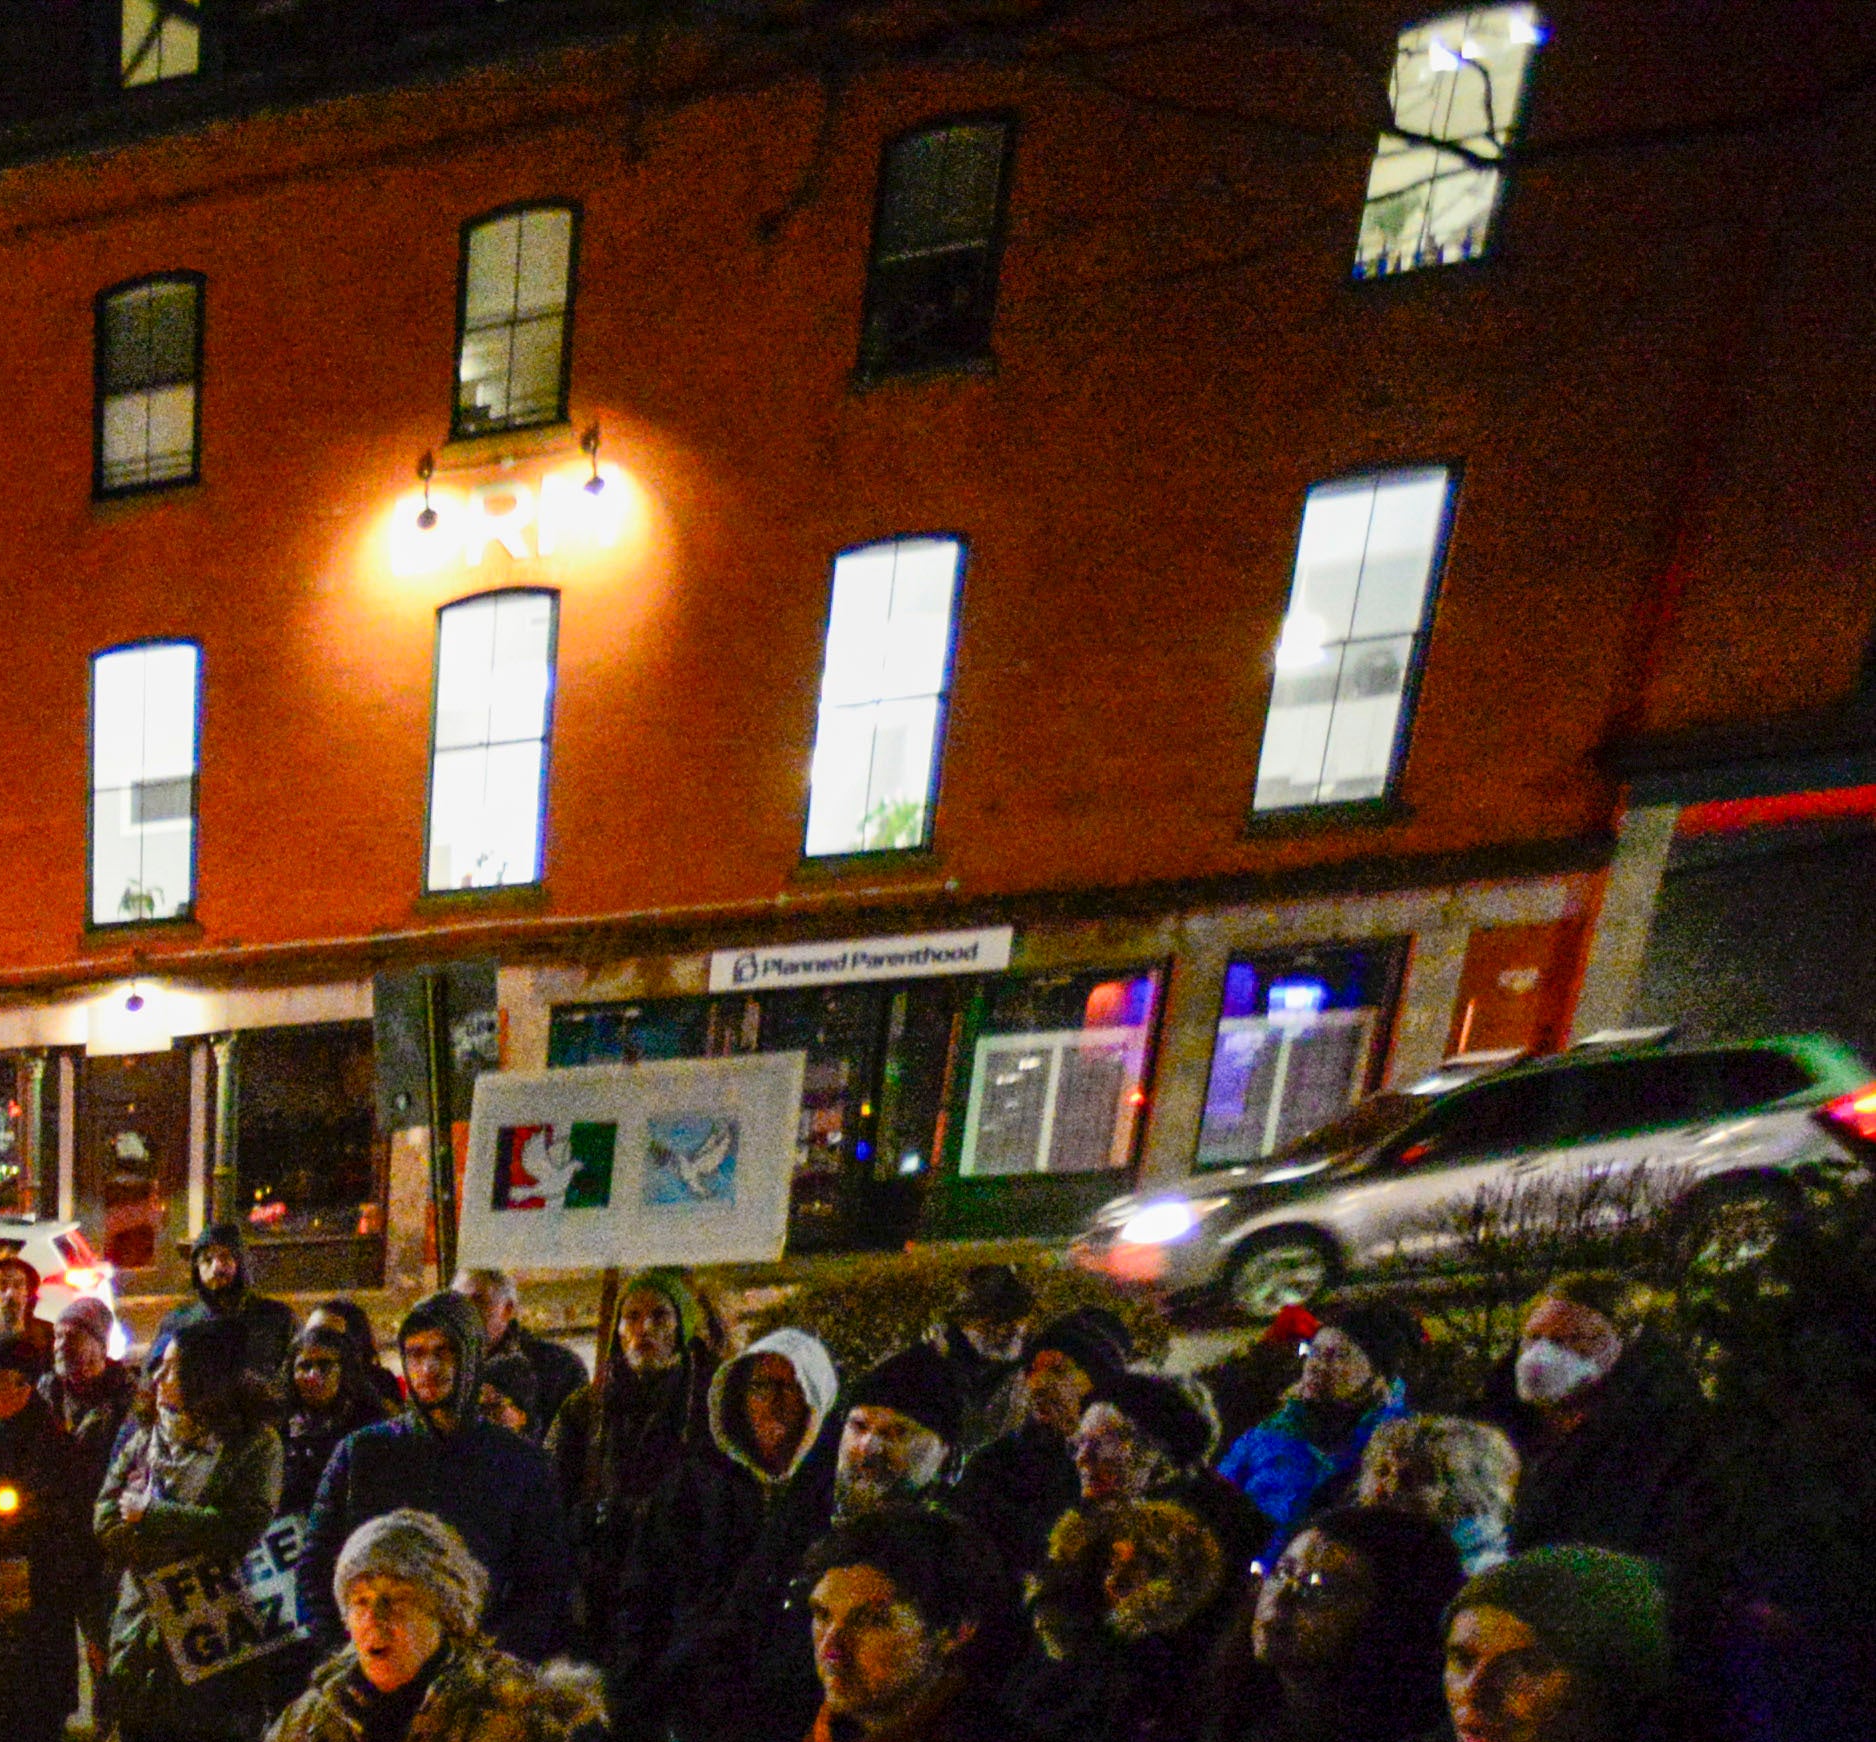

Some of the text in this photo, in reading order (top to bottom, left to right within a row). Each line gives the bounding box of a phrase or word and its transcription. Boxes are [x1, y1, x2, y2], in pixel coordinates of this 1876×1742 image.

[761, 941, 979, 978] Planned Parenthood
[163, 1526, 300, 1616] FREE
[181, 1592, 298, 1666] GAZ
